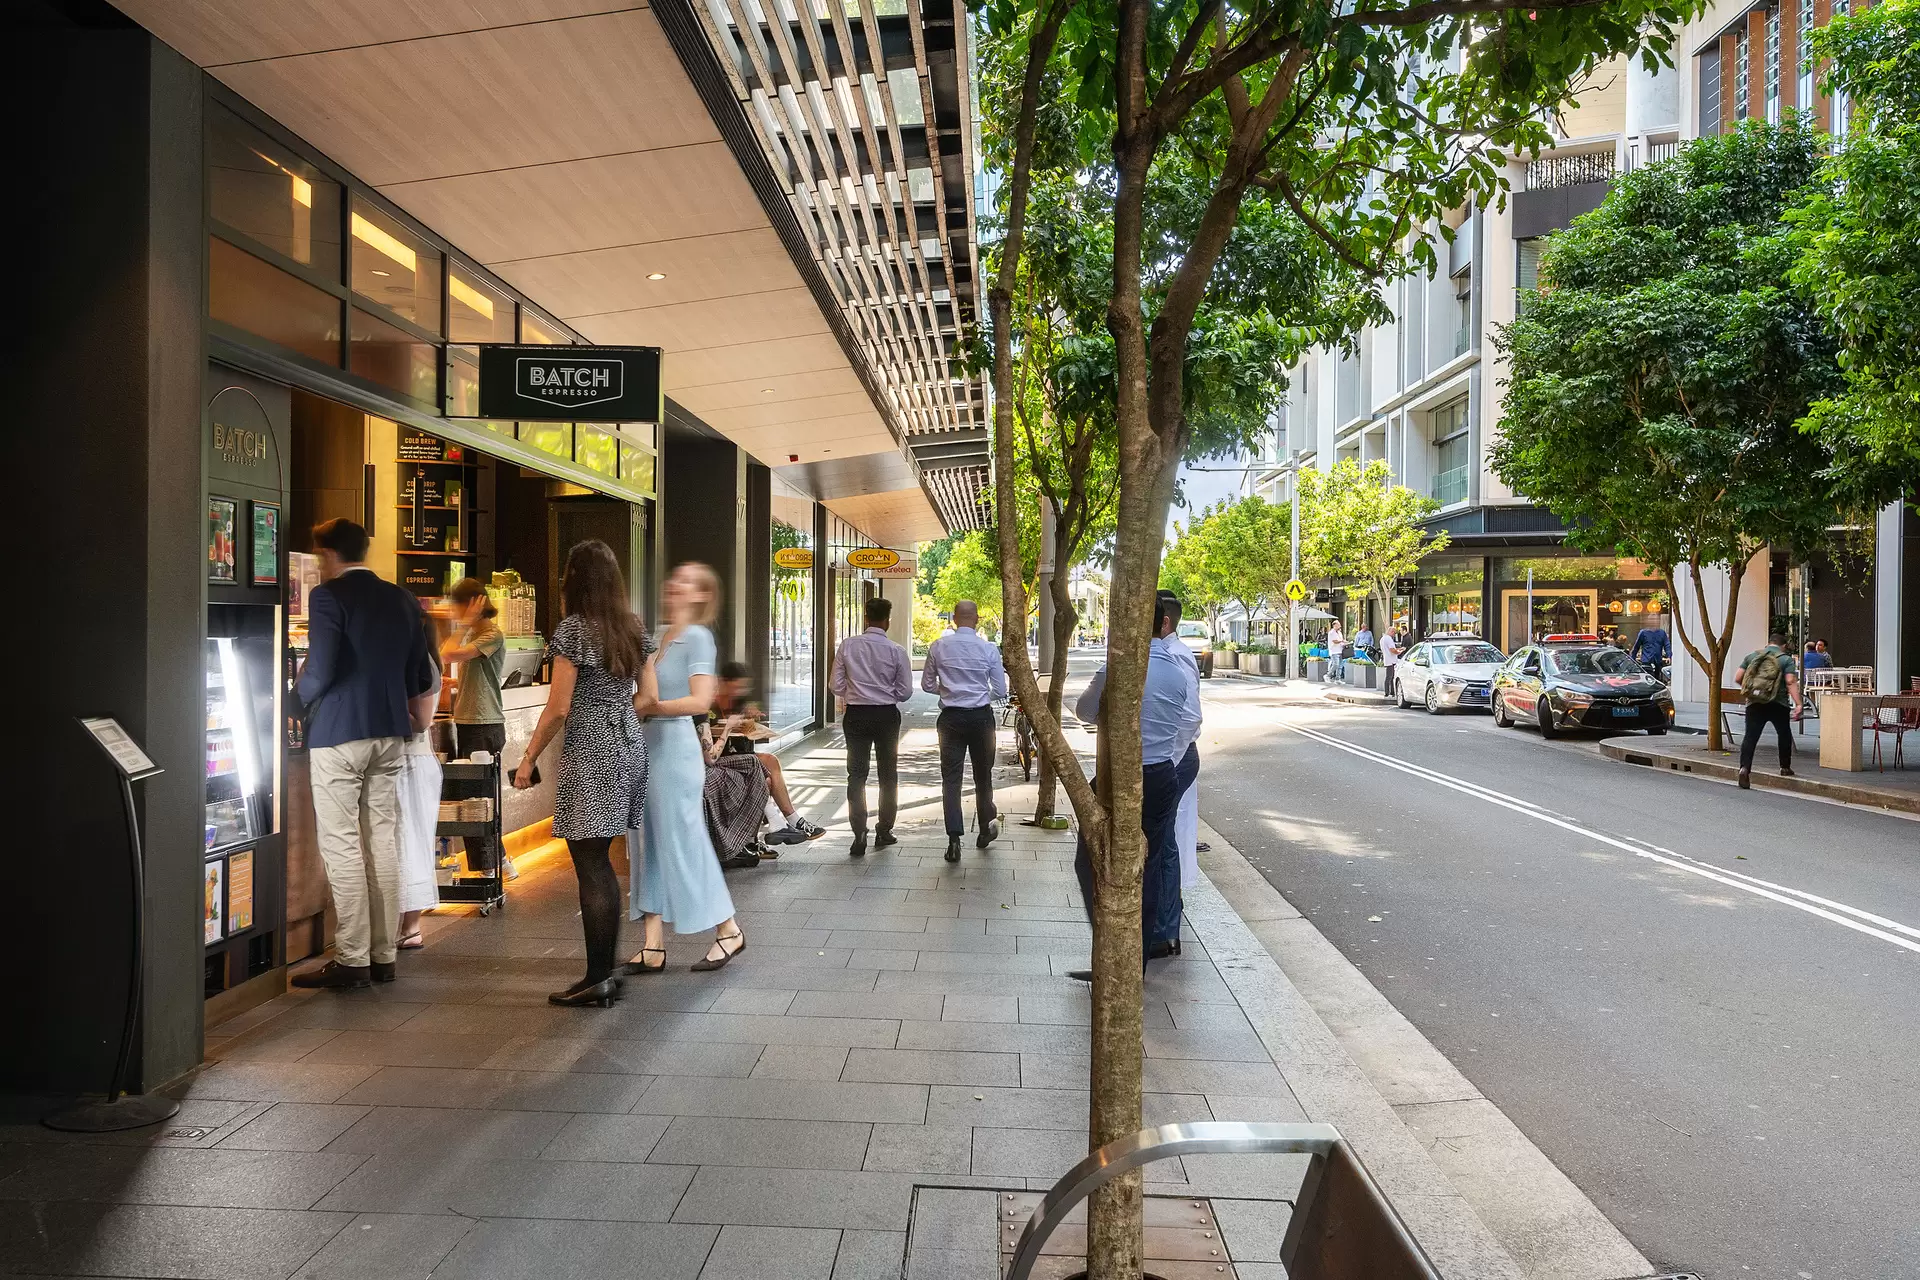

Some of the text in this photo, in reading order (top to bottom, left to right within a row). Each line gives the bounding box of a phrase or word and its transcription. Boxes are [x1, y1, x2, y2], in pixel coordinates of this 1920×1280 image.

[530, 366, 609, 388] BATCH
[541, 388, 598, 397] ESPRESSO
[213, 423, 266, 460] BATCH
[223, 453, 257, 467] ESPRESSO
[736, 497, 746, 520] 17
[856, 551, 890, 562] CROWN
